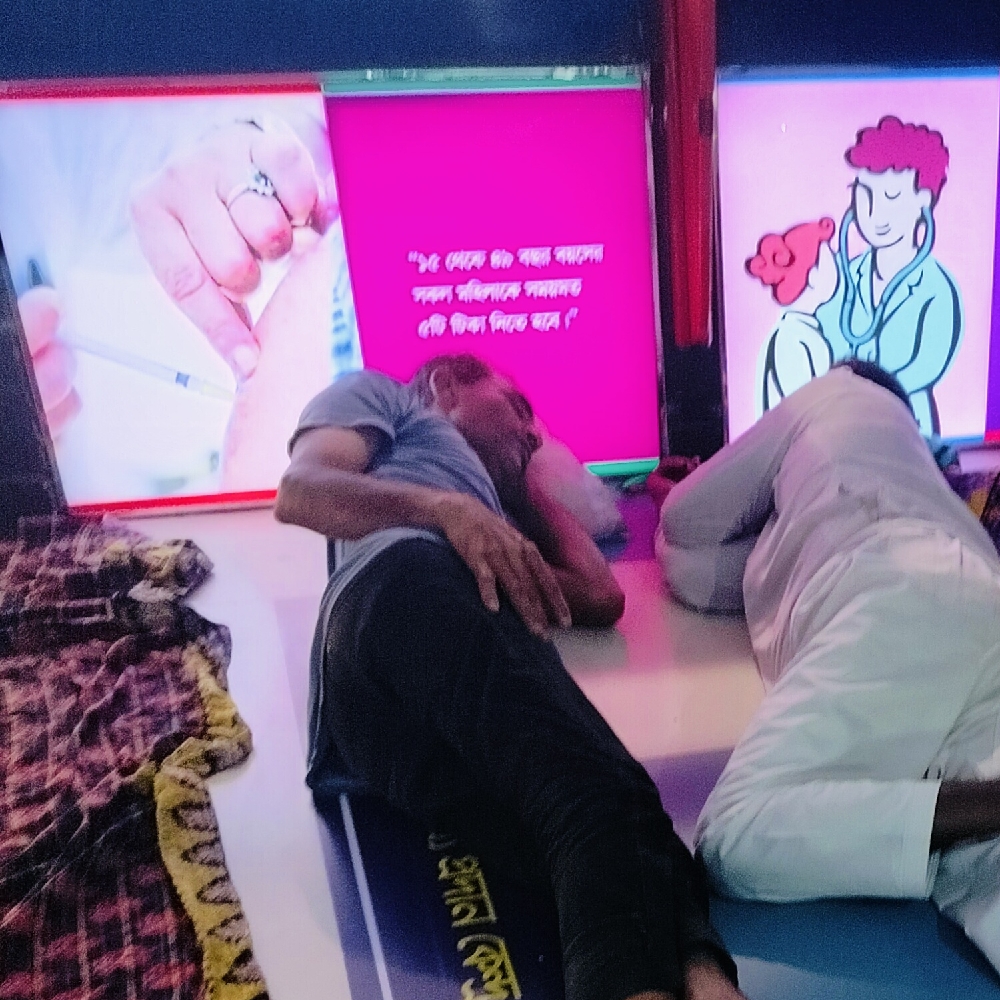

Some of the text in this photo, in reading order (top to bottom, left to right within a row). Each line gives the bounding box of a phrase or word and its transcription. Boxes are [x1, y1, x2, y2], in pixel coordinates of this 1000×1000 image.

[445, 249, 487, 272] থেকে
[517, 247, 552, 269] বছর
[449, 312, 487, 336] টিকা
[489, 310, 529, 335] নিতে
